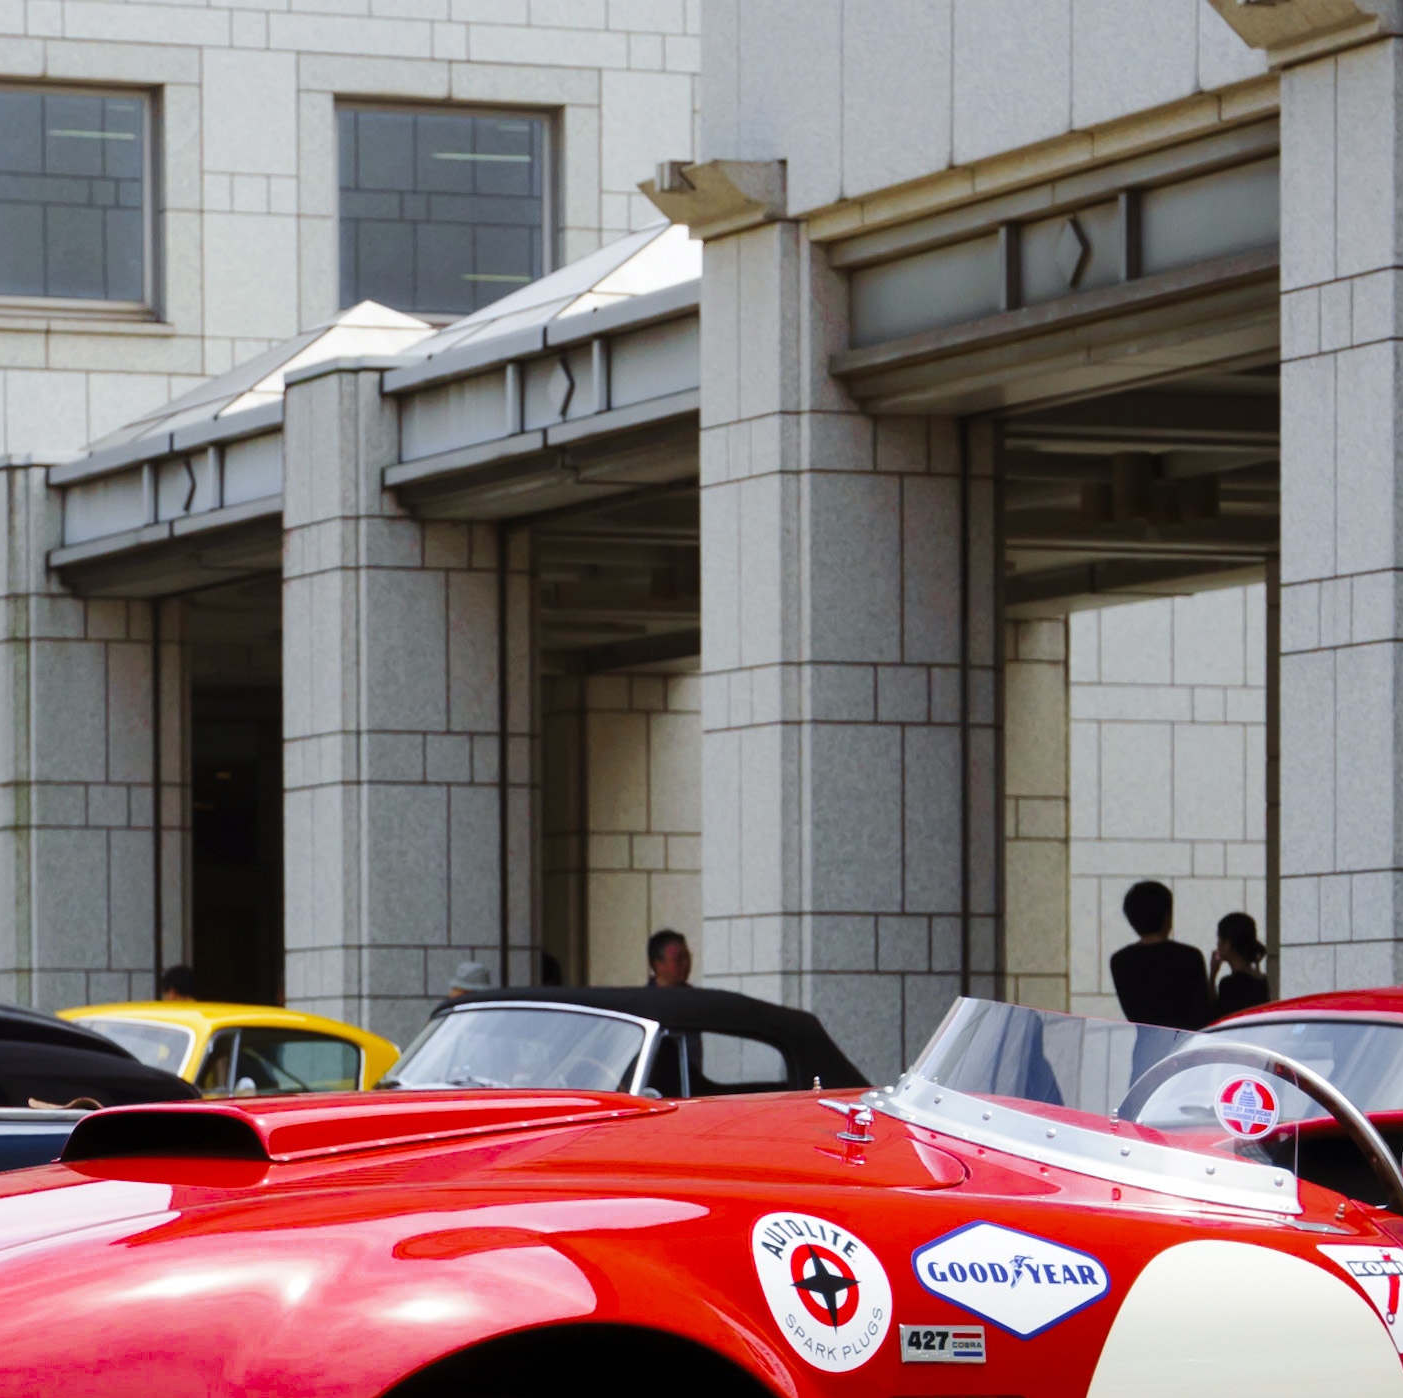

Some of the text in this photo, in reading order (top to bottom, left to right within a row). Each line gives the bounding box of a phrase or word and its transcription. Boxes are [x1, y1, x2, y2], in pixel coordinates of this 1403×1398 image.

[760, 1218, 859, 1261] AUTOLITE
[927, 1261, 1099, 1286] GOOD YEAR
[784, 1306, 884, 1362] SPARK PLUGS
[907, 1330, 949, 1351] 427
[951, 1341, 983, 1349] COBRA
